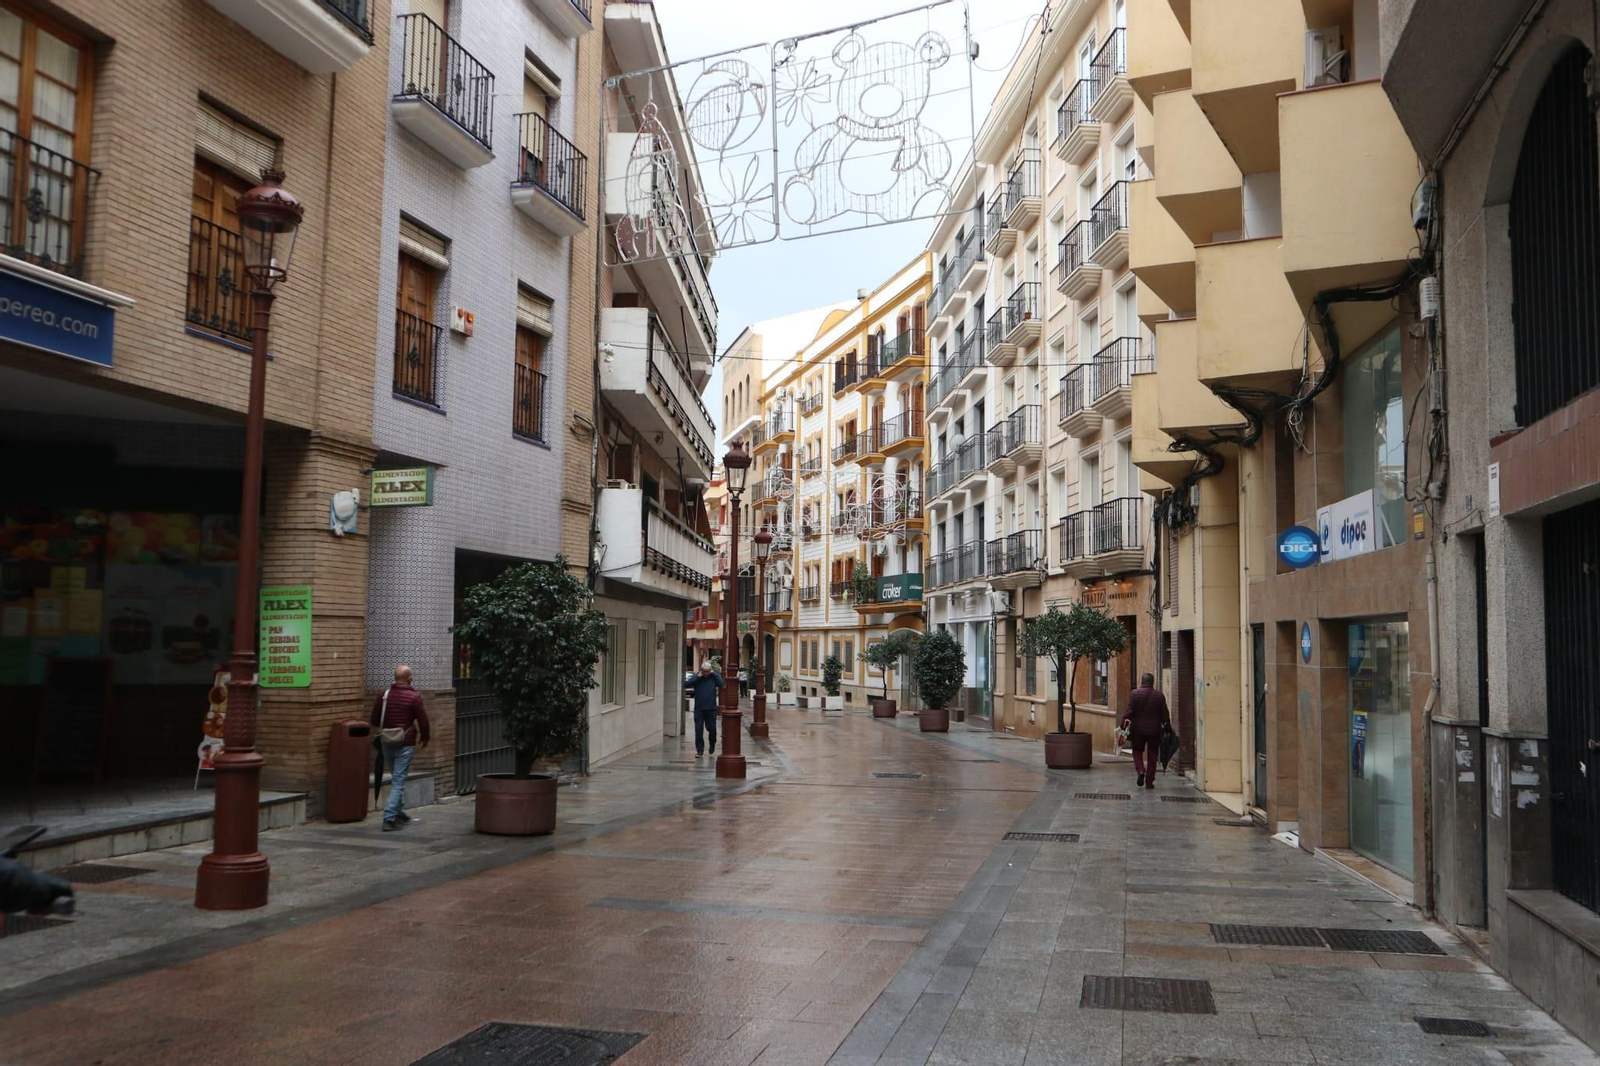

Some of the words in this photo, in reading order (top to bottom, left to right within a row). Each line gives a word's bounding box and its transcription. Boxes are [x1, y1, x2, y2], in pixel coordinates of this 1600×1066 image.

[374, 470, 426, 478] ALIMENTACION
[374, 480, 425, 494] ALEX
[374, 496, 425, 504] ALIMENTACION
[1280, 544, 1318, 553] DIGI
[882, 583, 902, 599] croker
[263, 599, 307, 611] ALEX
[269, 626, 283, 634] PAN
[269, 635, 300, 644] BEBIDAS
[269, 645, 300, 654] CHUCHES
[269, 655, 291, 664] FRUTA
[269, 665, 306, 674] VERDURAS
[268, 675, 294, 684] DULCES
